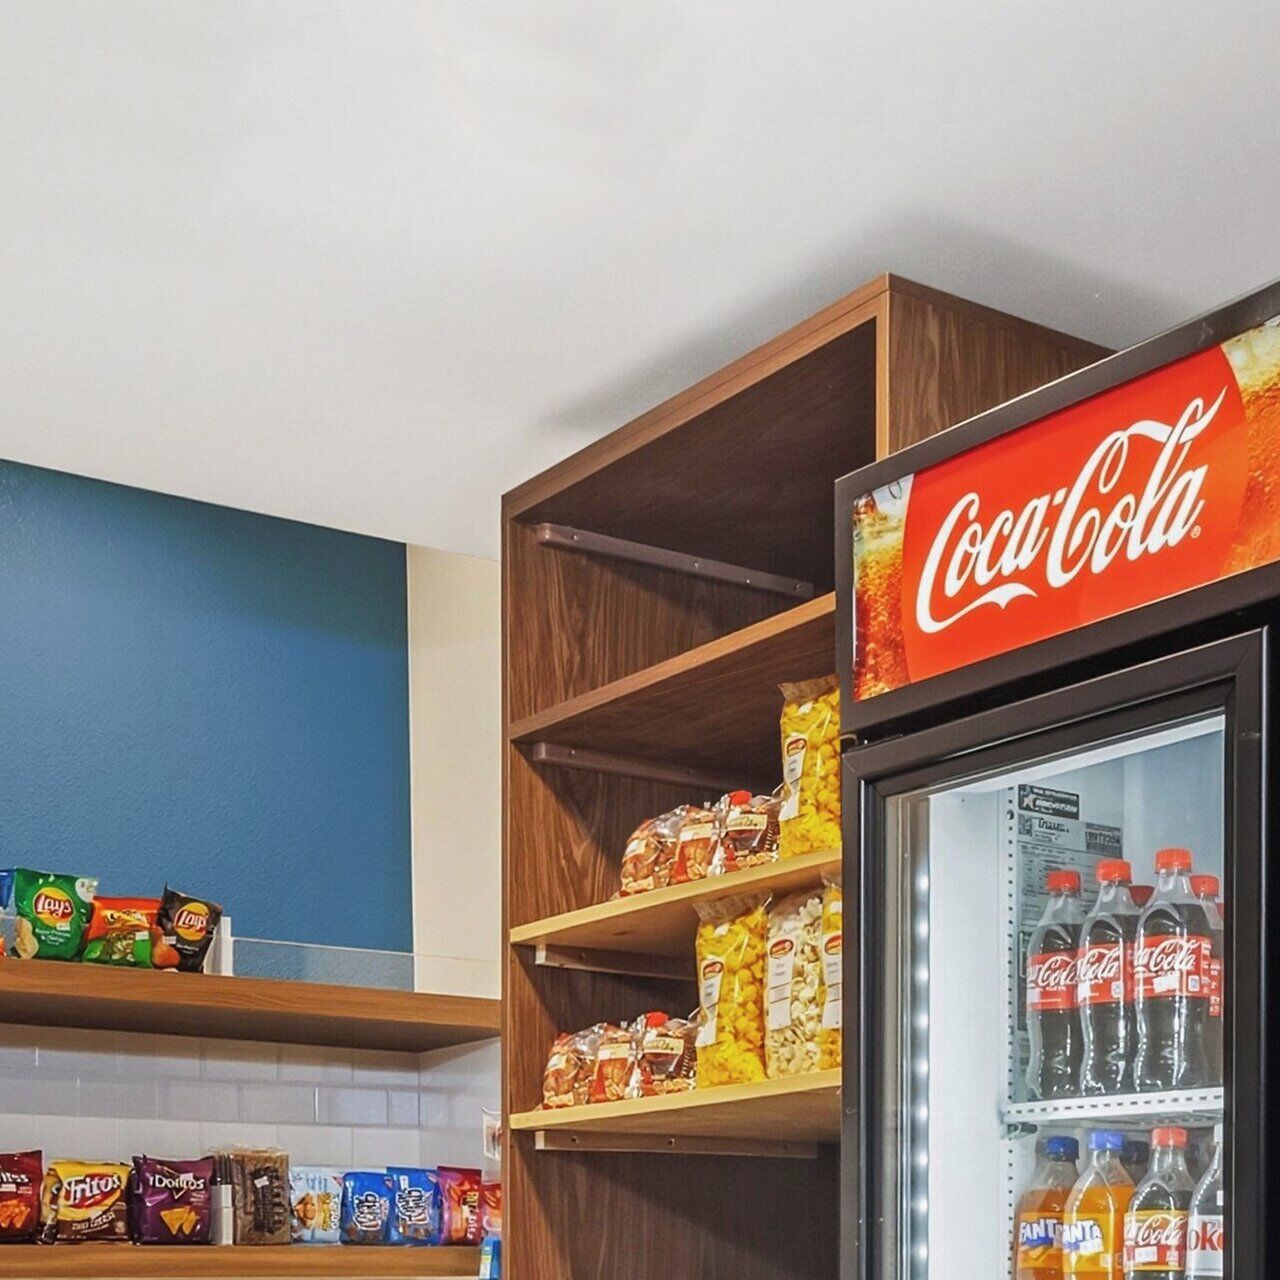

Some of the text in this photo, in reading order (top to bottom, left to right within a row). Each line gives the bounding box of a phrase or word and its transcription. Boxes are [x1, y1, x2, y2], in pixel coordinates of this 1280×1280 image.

[916, 388, 1227, 637] Coca-Cola
[64, 1174, 121, 1204] Fritos
[155, 1175, 205, 1190] Doritos
